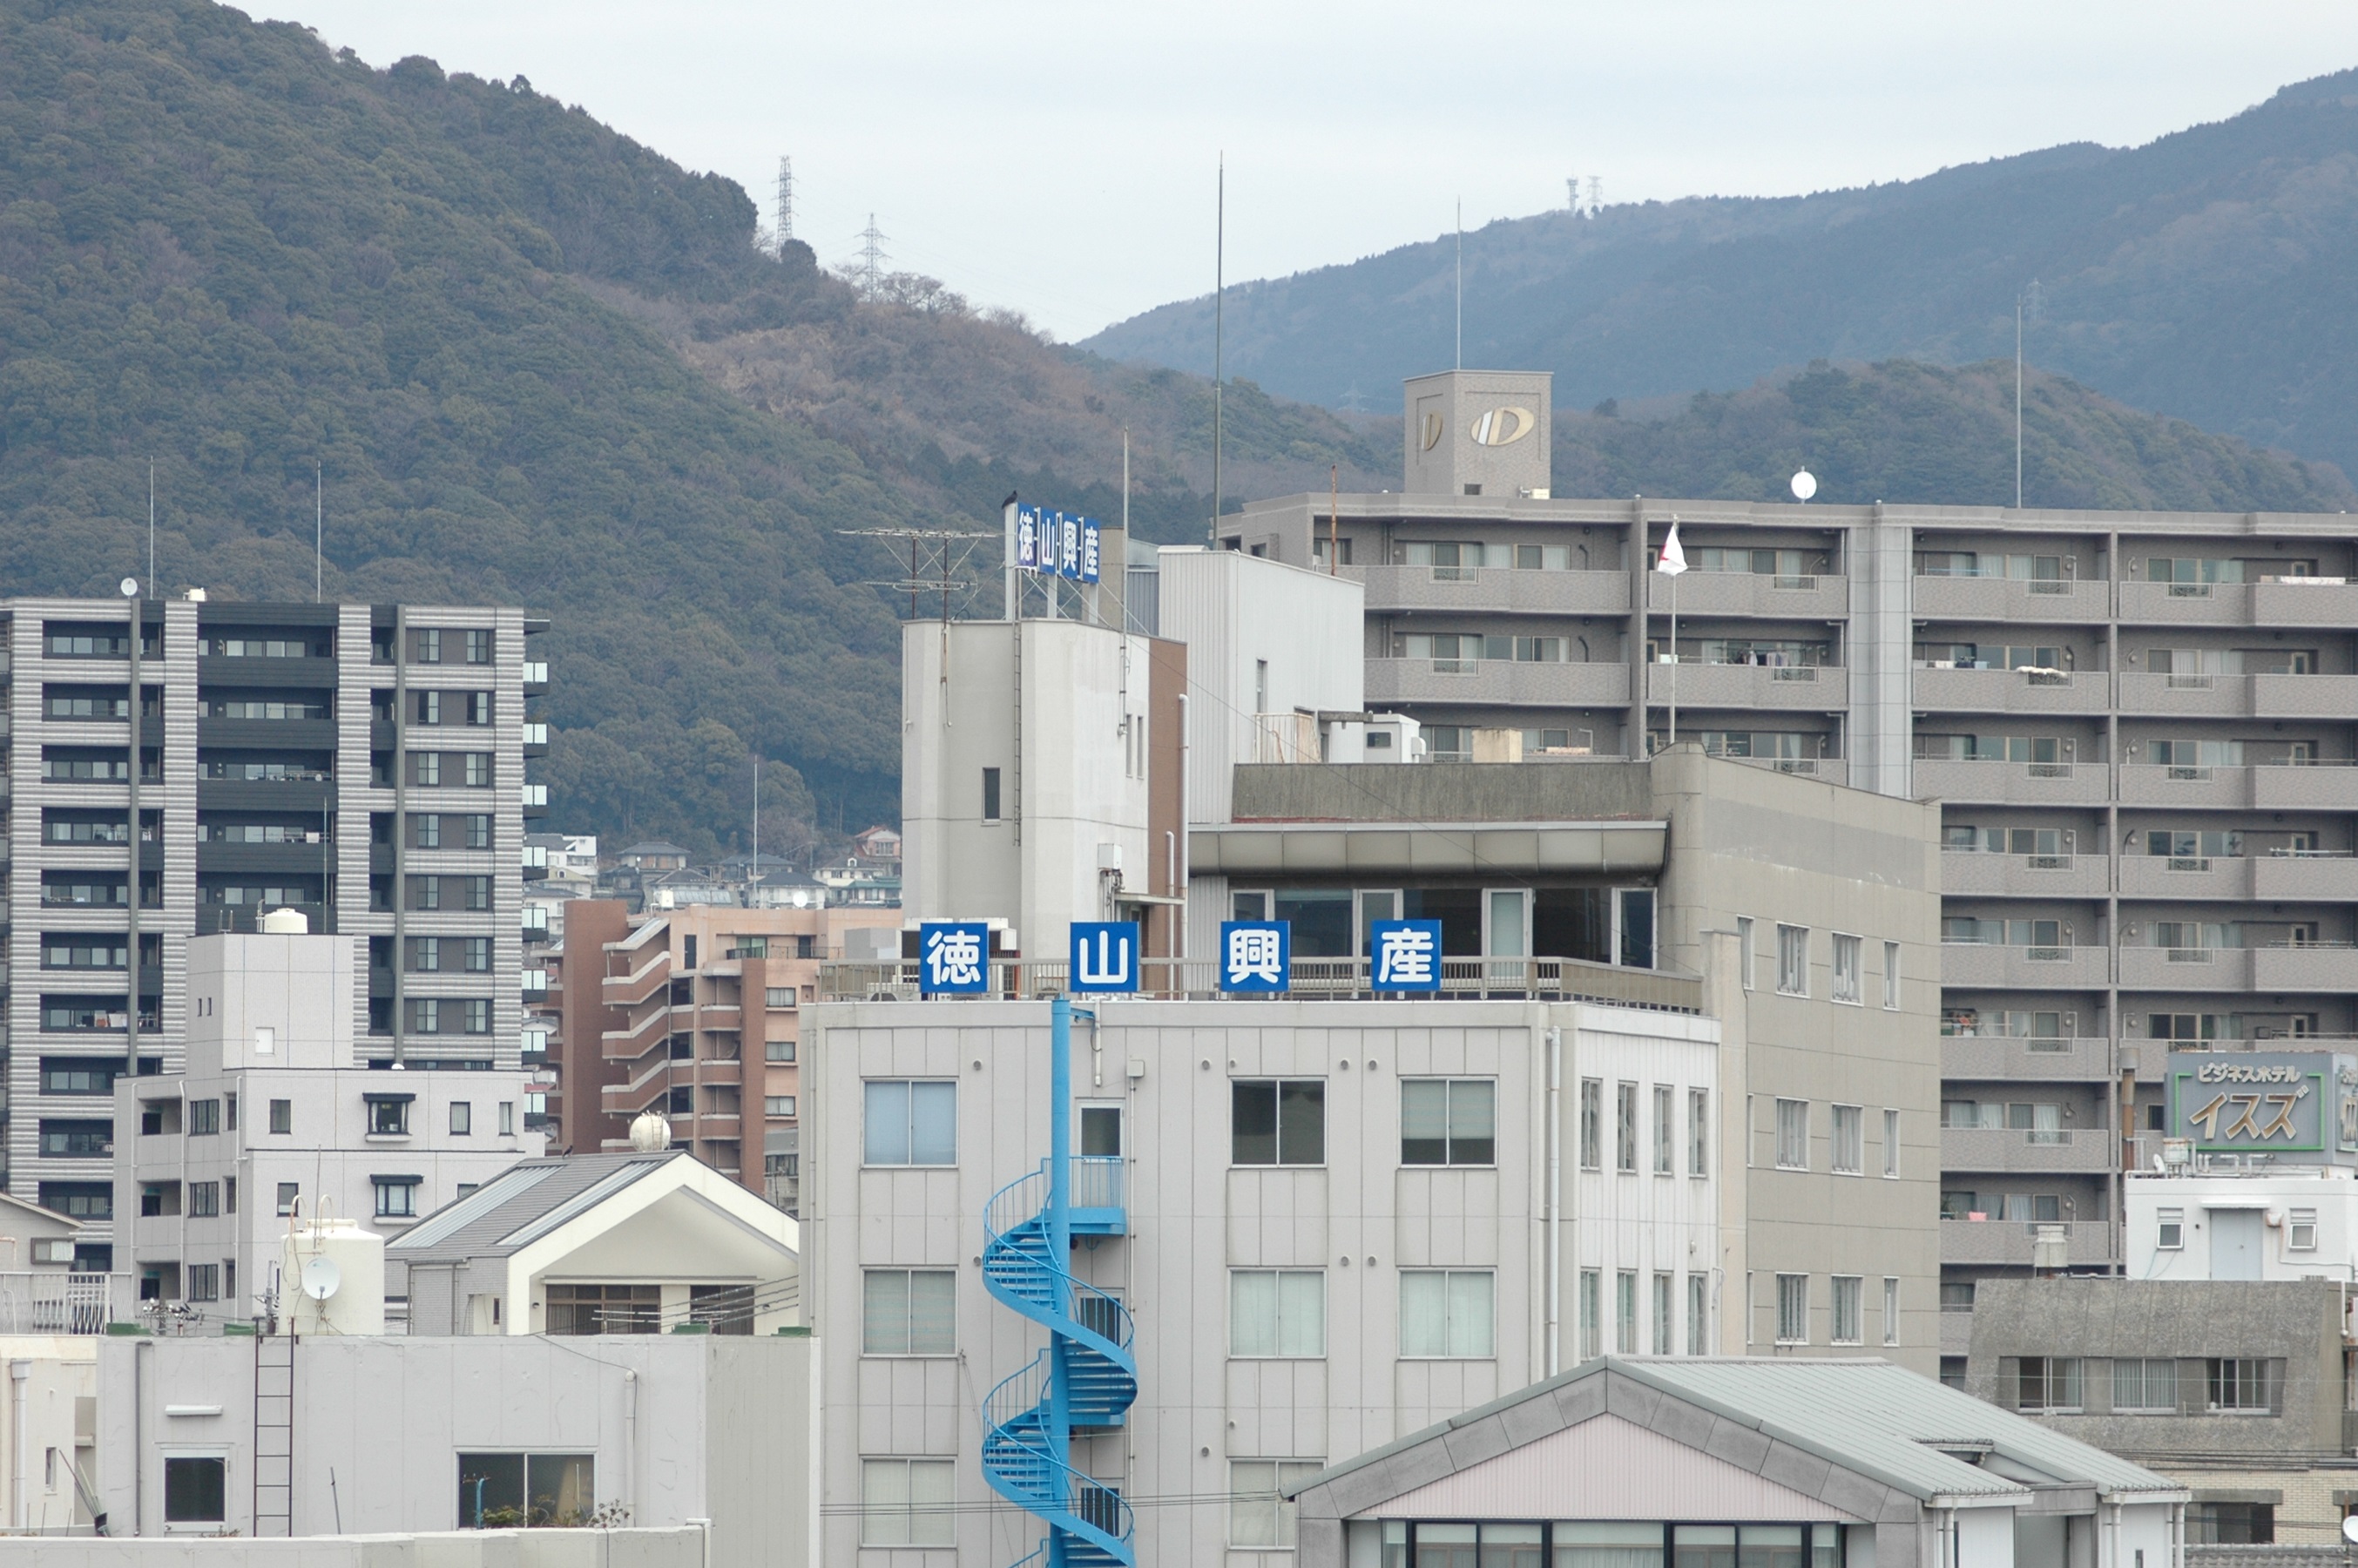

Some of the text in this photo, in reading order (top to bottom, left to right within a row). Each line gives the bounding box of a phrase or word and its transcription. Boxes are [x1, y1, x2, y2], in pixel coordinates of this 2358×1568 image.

[1019, 511, 1098, 575] 徳山興産
[927, 928, 1434, 986] 徳山興産
[2198, 1060, 2301, 1083] ビジネスホテル
[2189, 1085, 2310, 1140] イスズ
